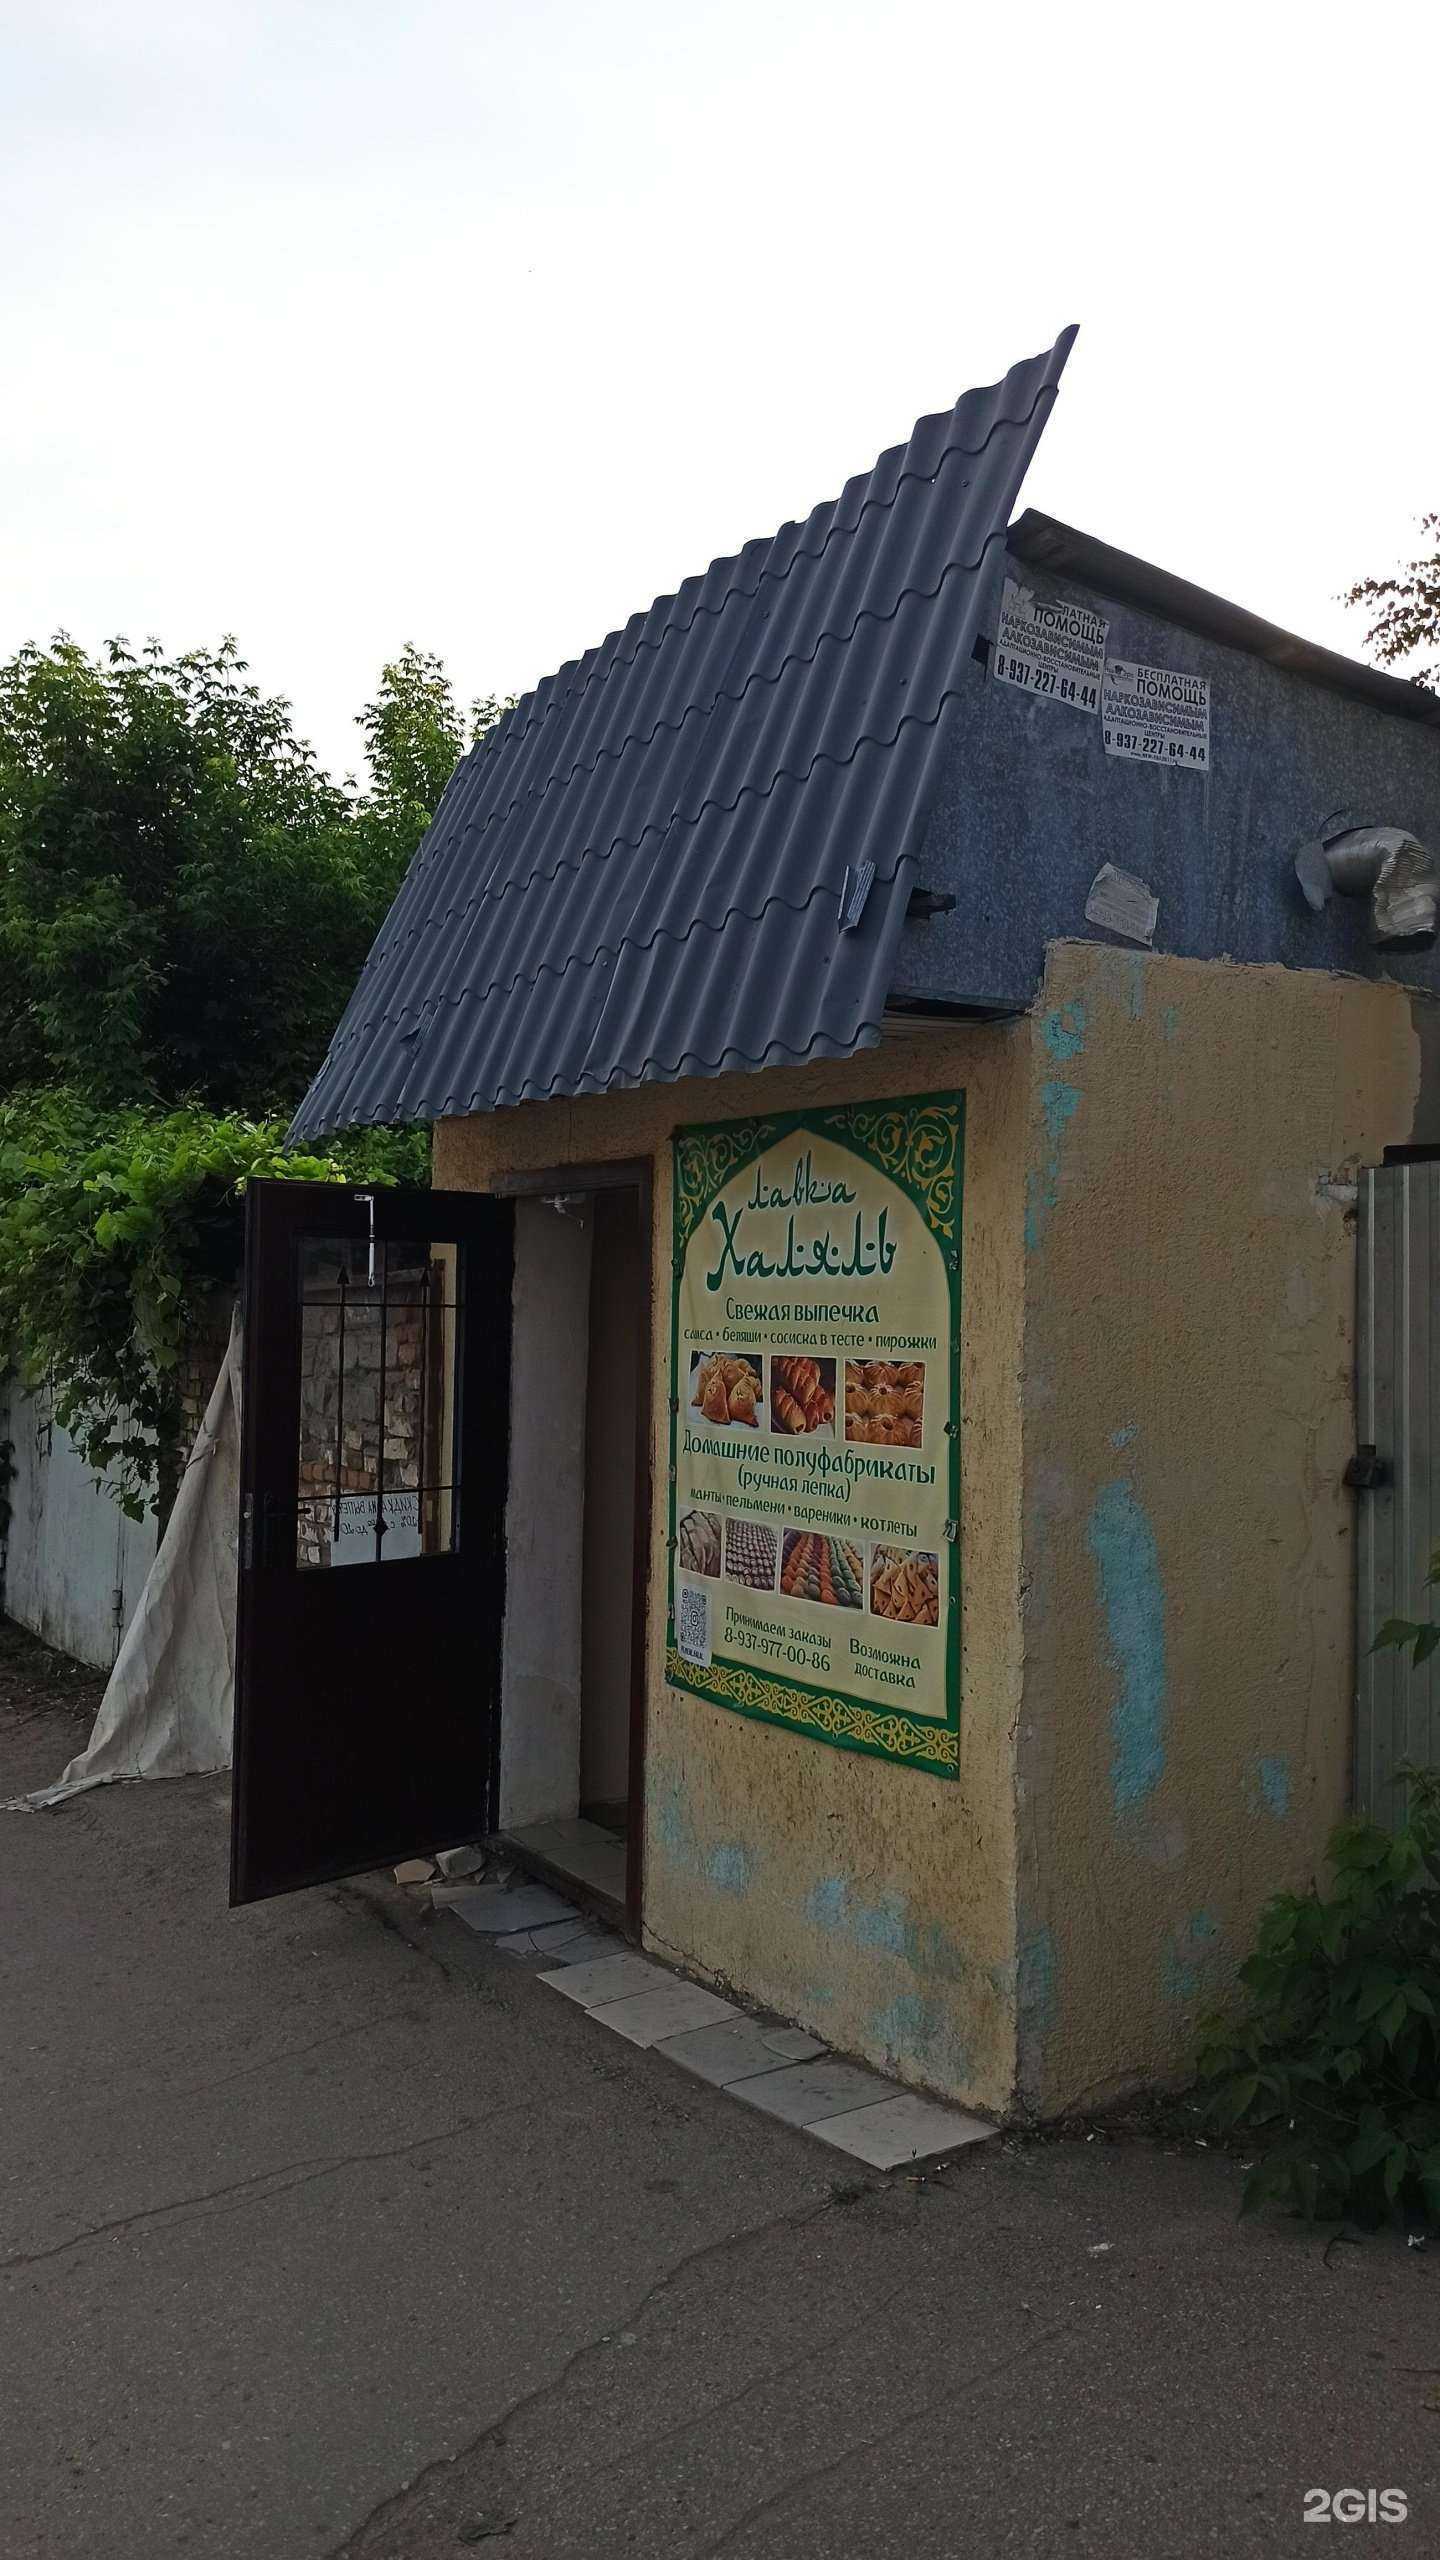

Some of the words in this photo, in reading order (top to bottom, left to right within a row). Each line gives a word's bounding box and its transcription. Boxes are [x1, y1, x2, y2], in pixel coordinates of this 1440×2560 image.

[1034, 607, 1104, 645] ПОМОЩЬ
[997, 654, 1097, 709] 8-937-227-64-44
[1136, 678, 1206, 706] ПОМОЩЬ
[1137, 667, 1206, 691] БЕСПЛАТНАЯ
[1104, 730, 1206, 761] 8-937-227-64-44
[706, 1201, 898, 1291] Халяль
[725, 1296, 791, 1322] Свежая
[794, 1303, 880, 1323] выпечка
[722, 1327, 762, 1344] беляши
[770, 1331, 818, 1346] сосиска
[820, 1334, 828, 1345] в
[831, 1333, 865, 1347] тесте
[875, 1333, 938, 1352] пирожки
[683, 1429, 771, 1465] Домашние
[774, 1446, 937, 1486] полуфабрикаты
[738, 1466, 799, 1493] (ручная
[801, 1478, 852, 1503] лепка)
[726, 1491, 785, 1515] пельмени
[794, 1506, 851, 1526] вареники
[861, 1515, 918, 1538] котлеты
[726, 1606, 786, 1637] Принимаем
[789, 1627, 832, 1649] заказы
[724, 1627, 831, 1672] 8-937-977-00-86
[850, 1637, 921, 1670] Возможна
[854, 1662, 916, 1689] доставка
